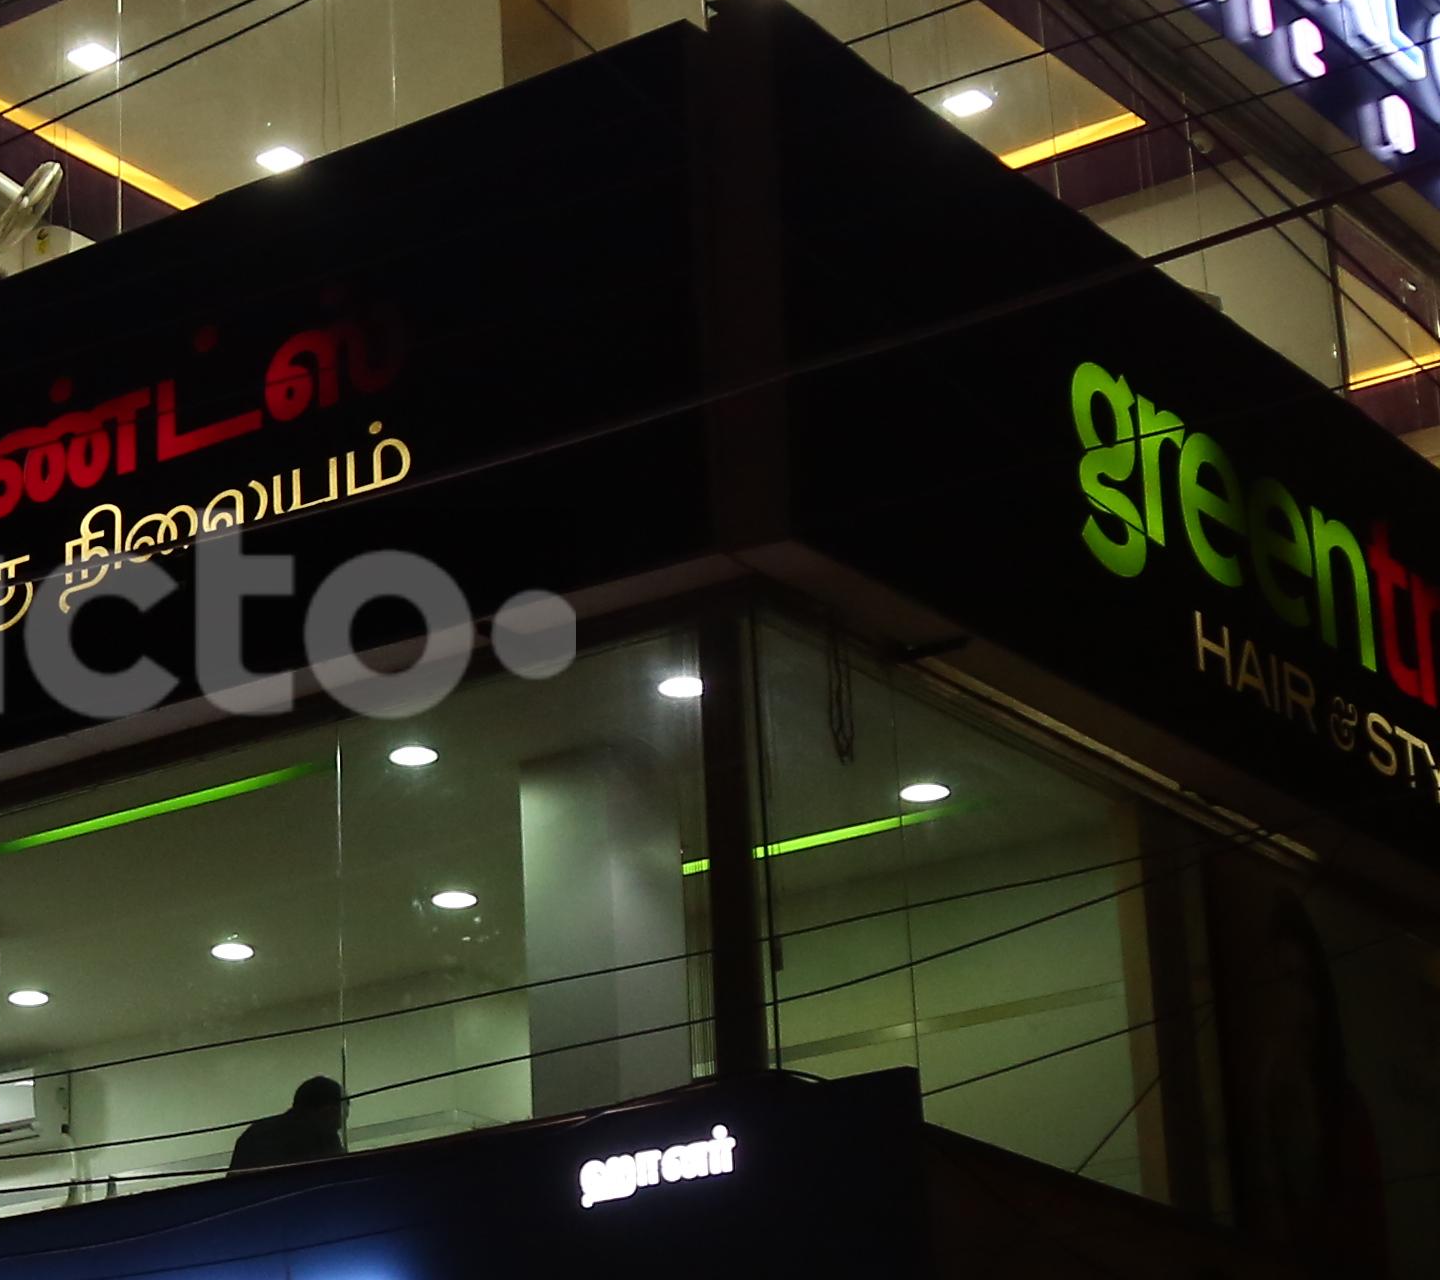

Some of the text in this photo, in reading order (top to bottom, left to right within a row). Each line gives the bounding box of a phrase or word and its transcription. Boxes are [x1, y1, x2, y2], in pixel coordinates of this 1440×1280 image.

[1377, 96, 1416, 155] n
[59, 421, 412, 614] நிலையம்
[1193, 609, 1319, 736] HAIR
